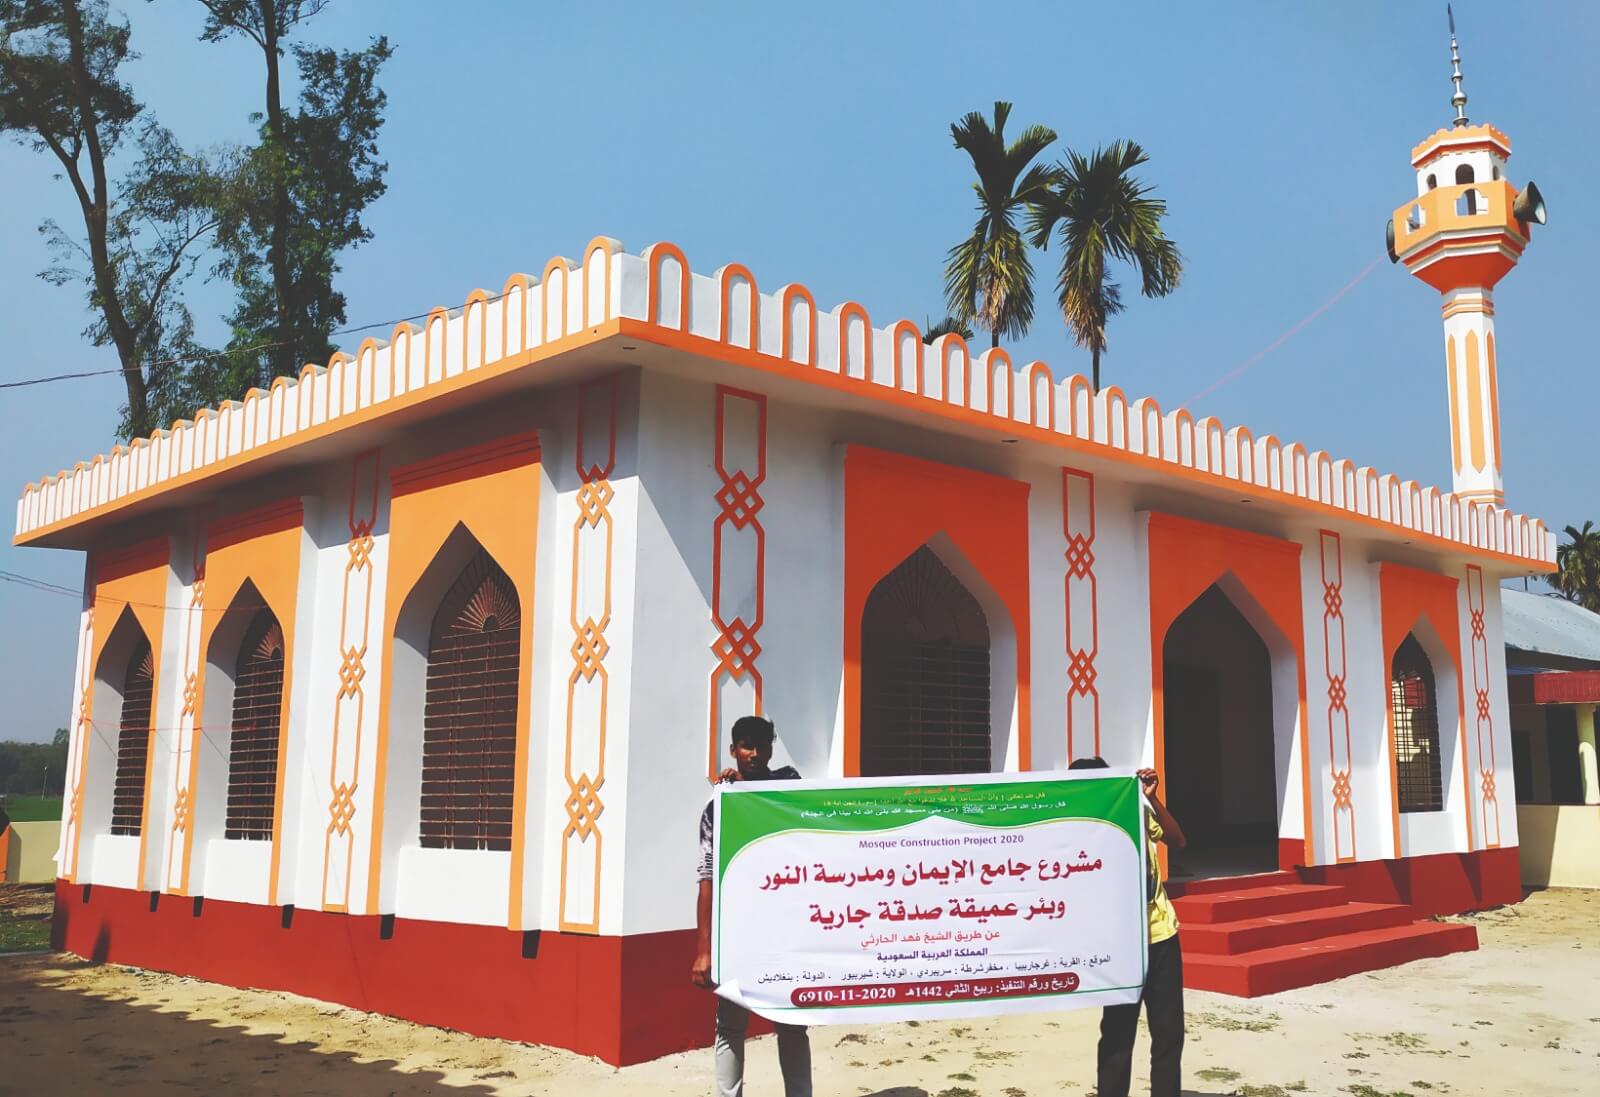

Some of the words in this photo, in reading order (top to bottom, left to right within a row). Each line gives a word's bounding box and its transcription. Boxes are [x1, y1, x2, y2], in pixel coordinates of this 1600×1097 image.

[858, 839, 897, 850] Mosque
[900, 837, 960, 848] Construction
[963, 835, 997, 847] Project
[1000, 834, 1024, 844] 2020
[901, 858, 974, 886] الإيمان
[980, 857, 1031, 885] جامع
[1038, 850, 1103, 881] مشروع
[759, 865, 807, 890] النور
[813, 863, 896, 888] ومدرسة
[808, 903, 871, 930] جارية
[877, 899, 943, 922] صدقة
[948, 897, 1018, 924] عميقة
[1022, 897, 1066, 921] وبئر
[860, 933, 898, 951] الحارثي
[900, 932, 921, 942] فهد
[923, 931, 952, 944] الشيخ
[954, 930, 982, 943] طريق
[984, 930, 1000, 941] عن
[876, 950, 919, 962] السعودية
[920, 949, 952, 961] العربية
[954, 947, 988, 958] المملكة
[1027, 977, 1050, 990] ورقم
[1051, 975, 1076, 989] تاريخ
[798, 986, 896, 1003] 6910-11-2020
[944, 983, 970, 998] الثاني
[972, 984, 993, 997] ربيع
